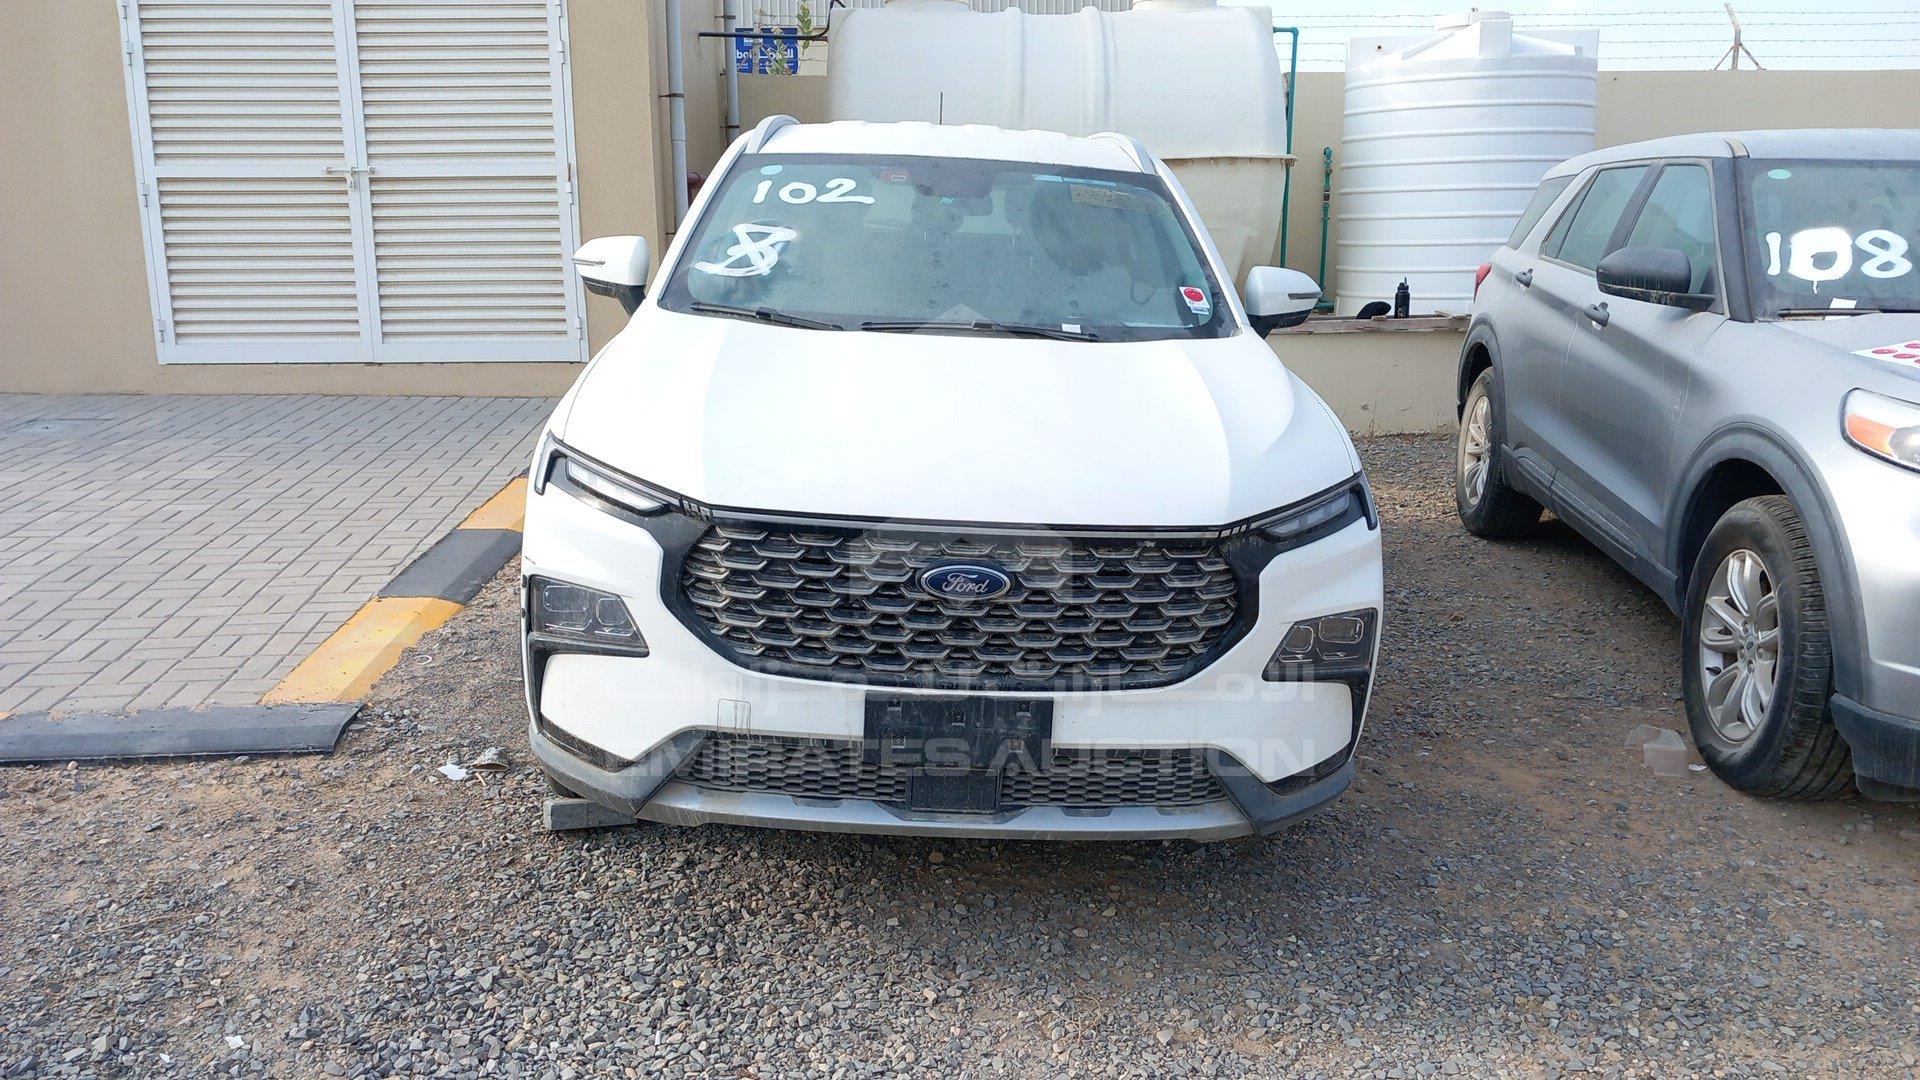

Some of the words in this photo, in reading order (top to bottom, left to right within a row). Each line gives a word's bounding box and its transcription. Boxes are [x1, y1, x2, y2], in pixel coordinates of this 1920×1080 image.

[753, 178, 876, 205] 102
[1765, 227, 1913, 284] 108
[942, 572, 989, 594] Ford
